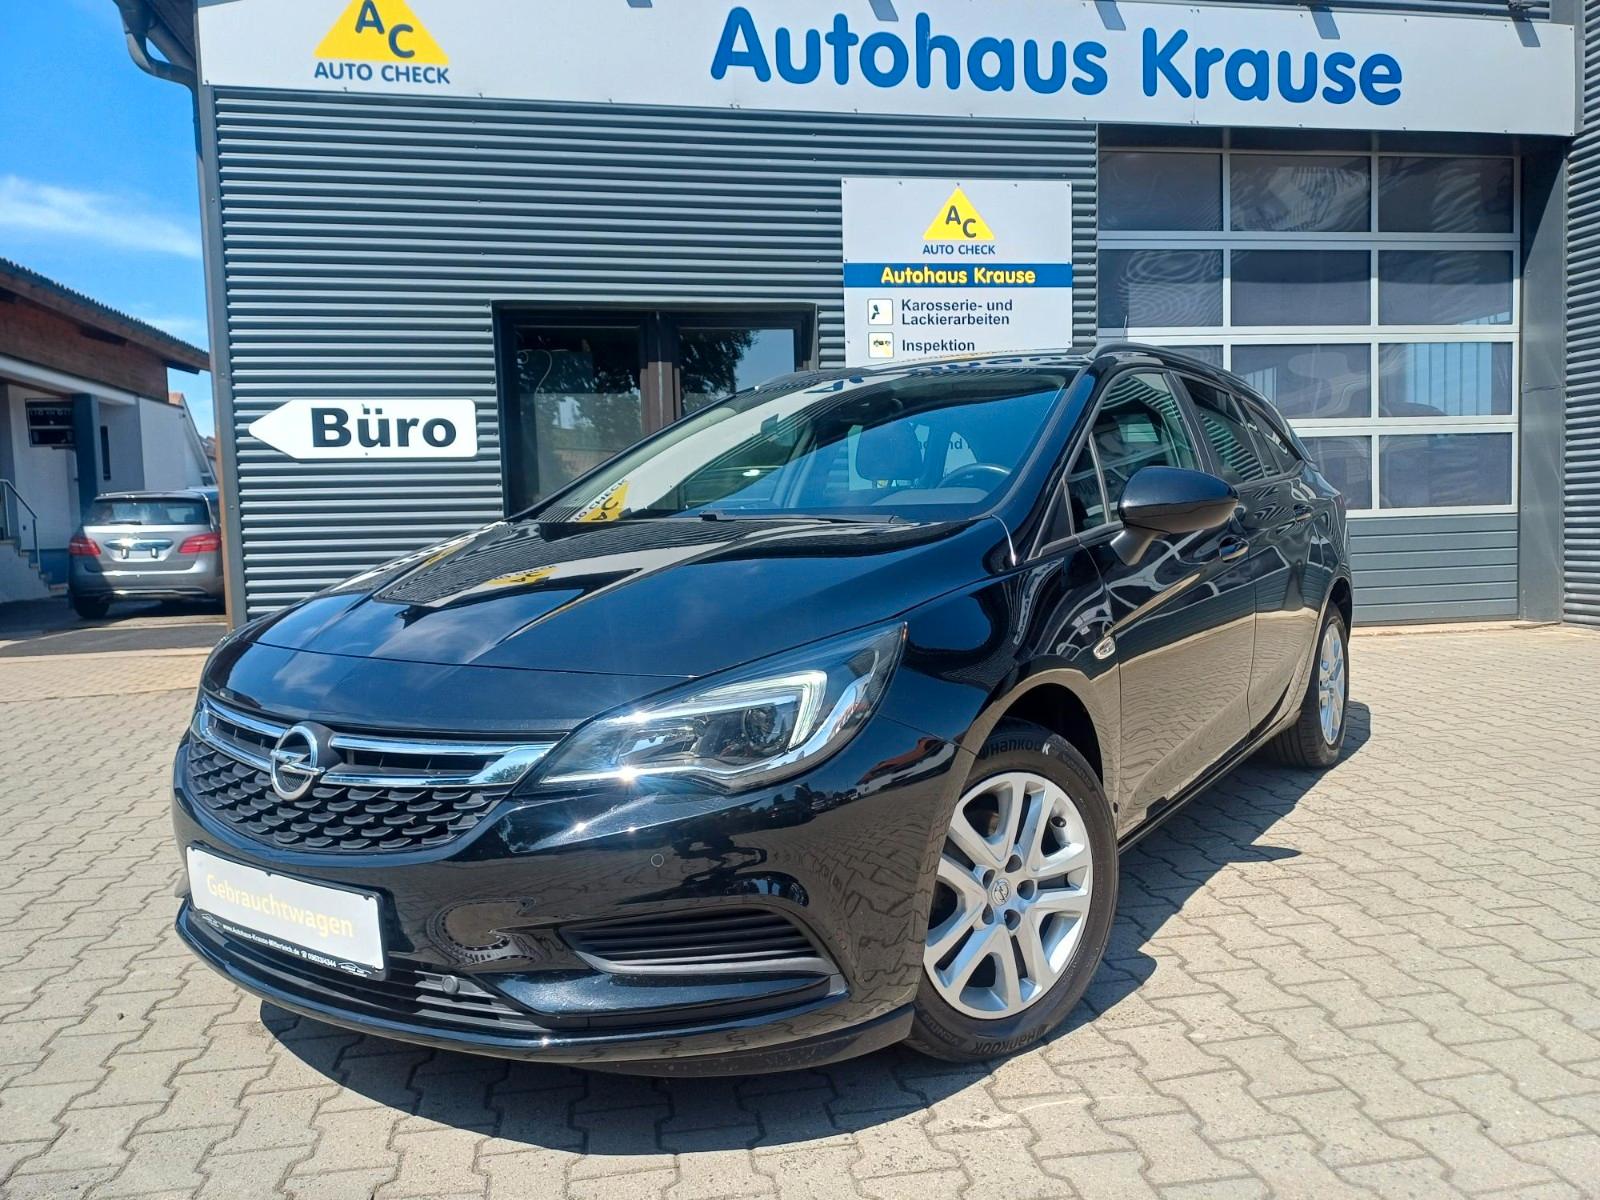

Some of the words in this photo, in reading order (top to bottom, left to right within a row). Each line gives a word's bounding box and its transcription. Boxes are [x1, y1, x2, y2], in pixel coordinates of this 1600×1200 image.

[710, 6, 1108, 96] Autohaus
[1142, 27, 1403, 106] Krause
[314, 61, 373, 82] AUTO
[381, 64, 451, 85] CHECK
[922, 244, 954, 255] AUTO
[958, 244, 996, 255] CHECK
[880, 266, 967, 284] Autohaus
[974, 267, 1036, 284] Krause
[902, 299, 982, 311] Karosserie-
[987, 299, 1013, 311] und
[902, 313, 1010, 326] Lackierarbeiten
[902, 339, 975, 354] Inspektion
[311, 408, 457, 448] Büro
[207, 874, 354, 938] Gebrauchtwagen
